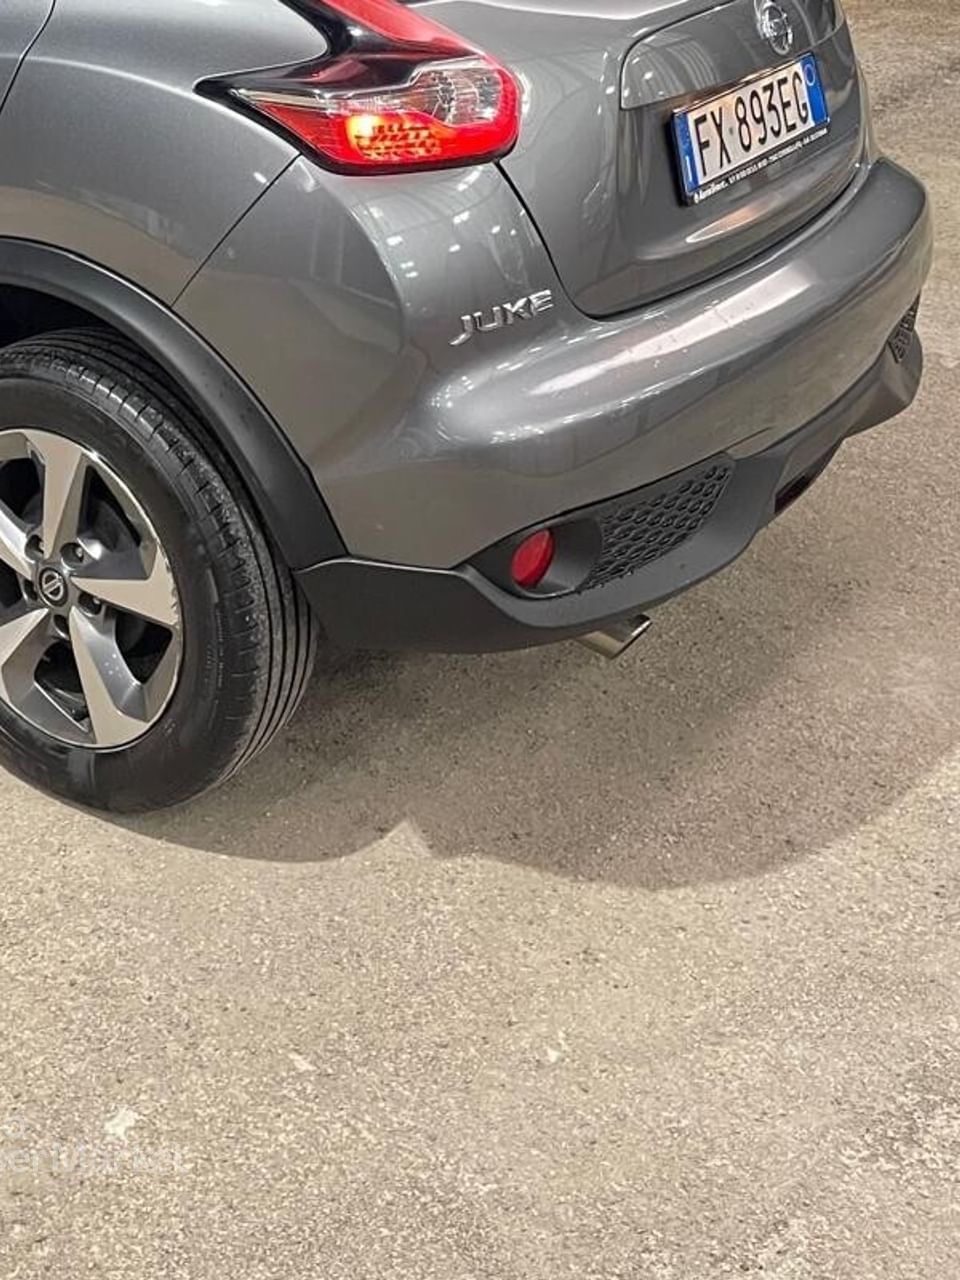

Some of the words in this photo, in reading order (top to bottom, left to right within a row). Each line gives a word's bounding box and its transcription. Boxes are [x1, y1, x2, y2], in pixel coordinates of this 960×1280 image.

[694, 106, 731, 177] FX
[734, 71, 809, 153] 893EG
[450, 289, 554, 346] JUKE
